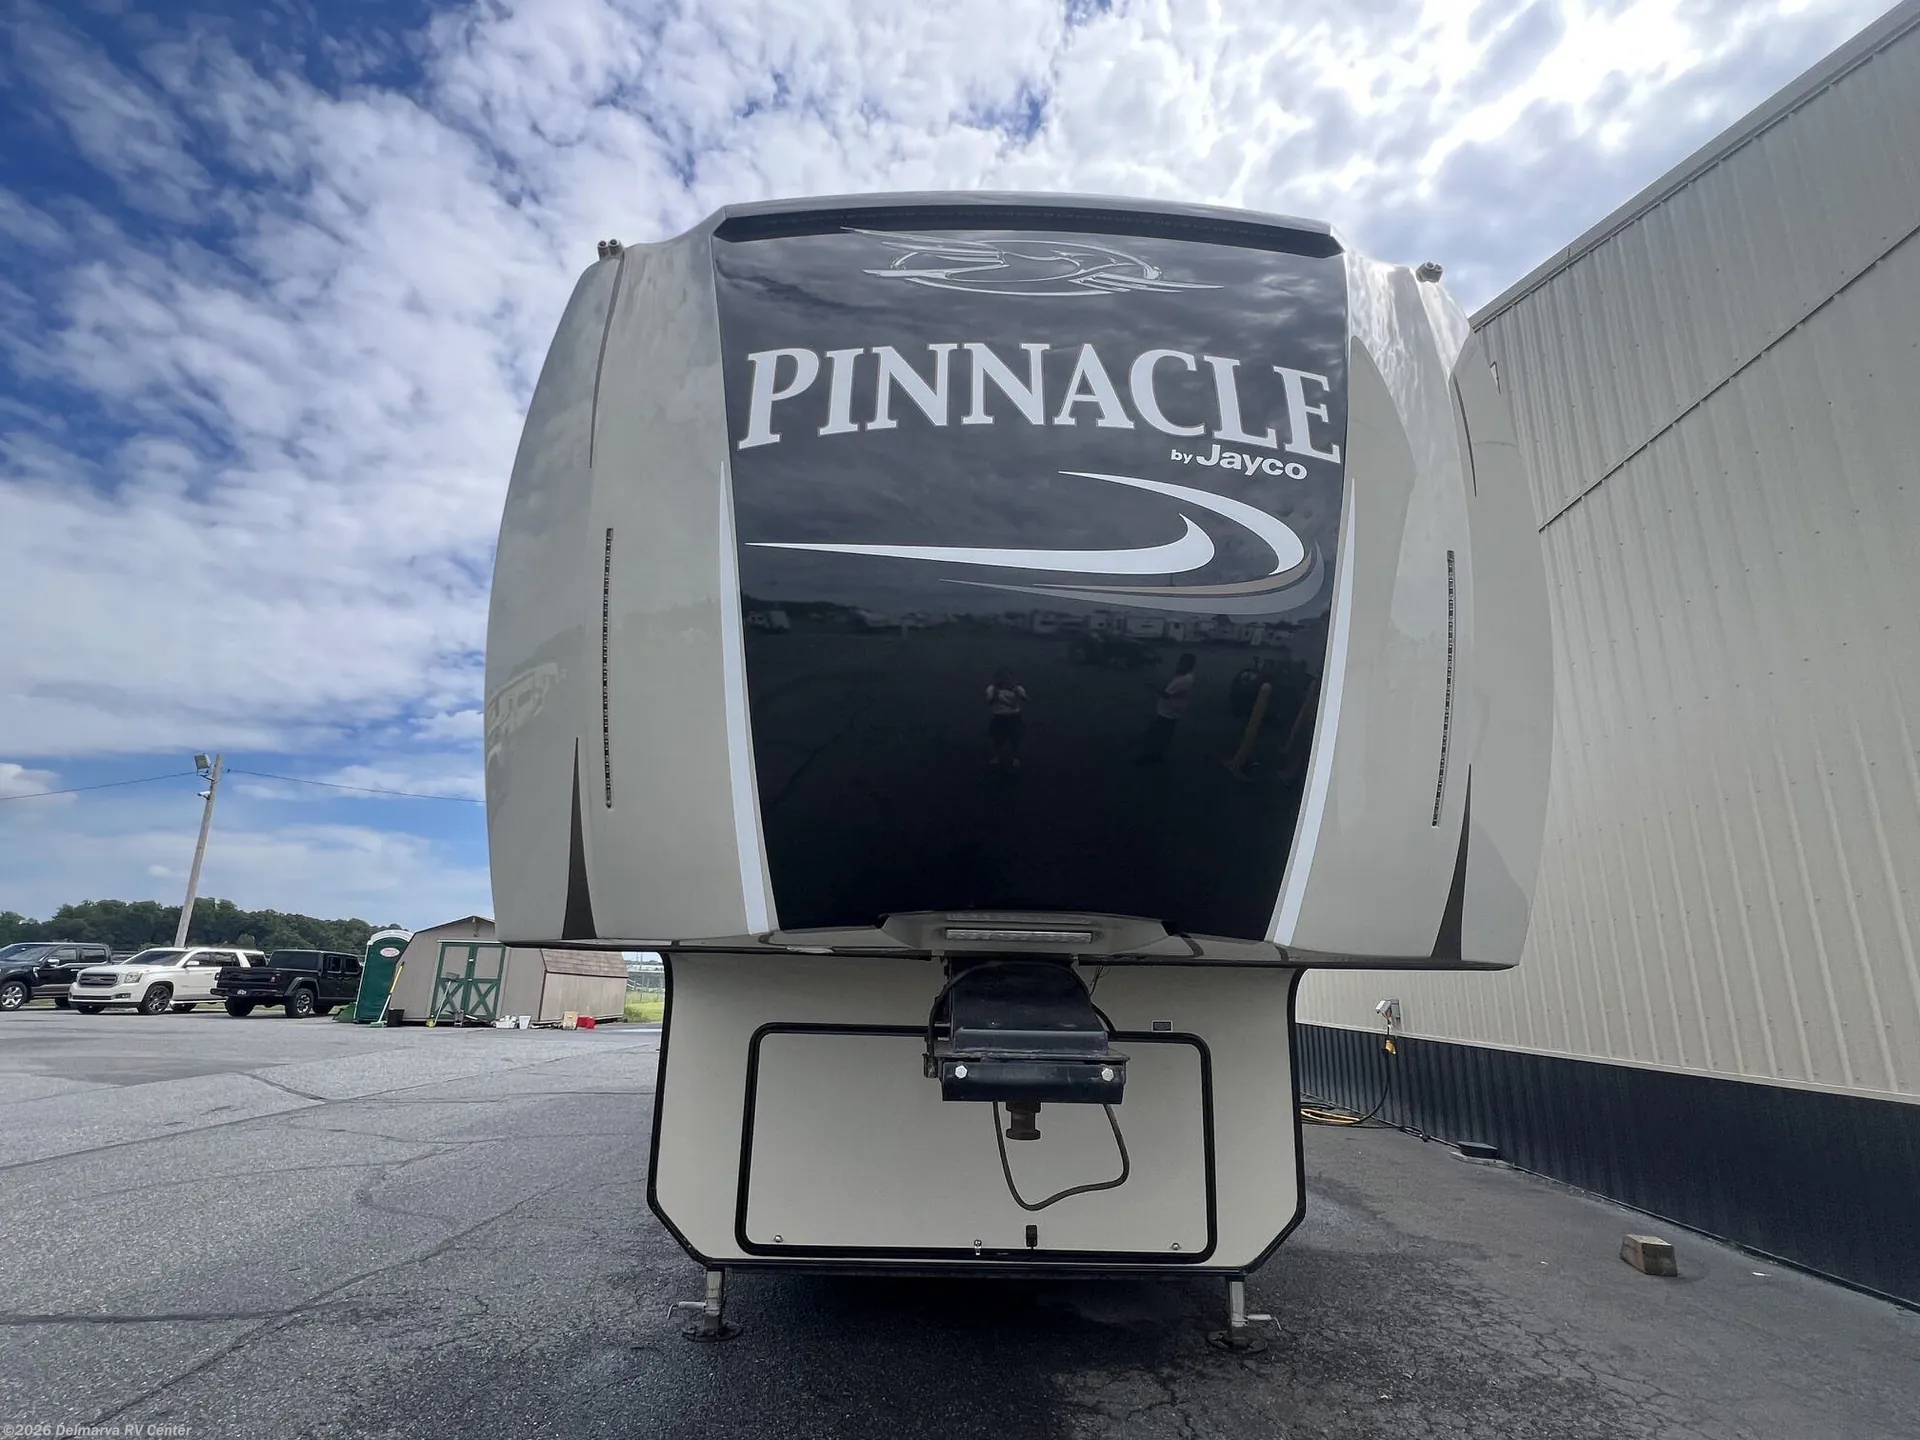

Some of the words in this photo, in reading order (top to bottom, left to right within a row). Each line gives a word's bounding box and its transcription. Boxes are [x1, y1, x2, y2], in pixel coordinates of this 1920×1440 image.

[737, 342, 1341, 465] PINNACLE
[1170, 449, 1193, 464] by
[1195, 443, 1308, 480] Jayco
